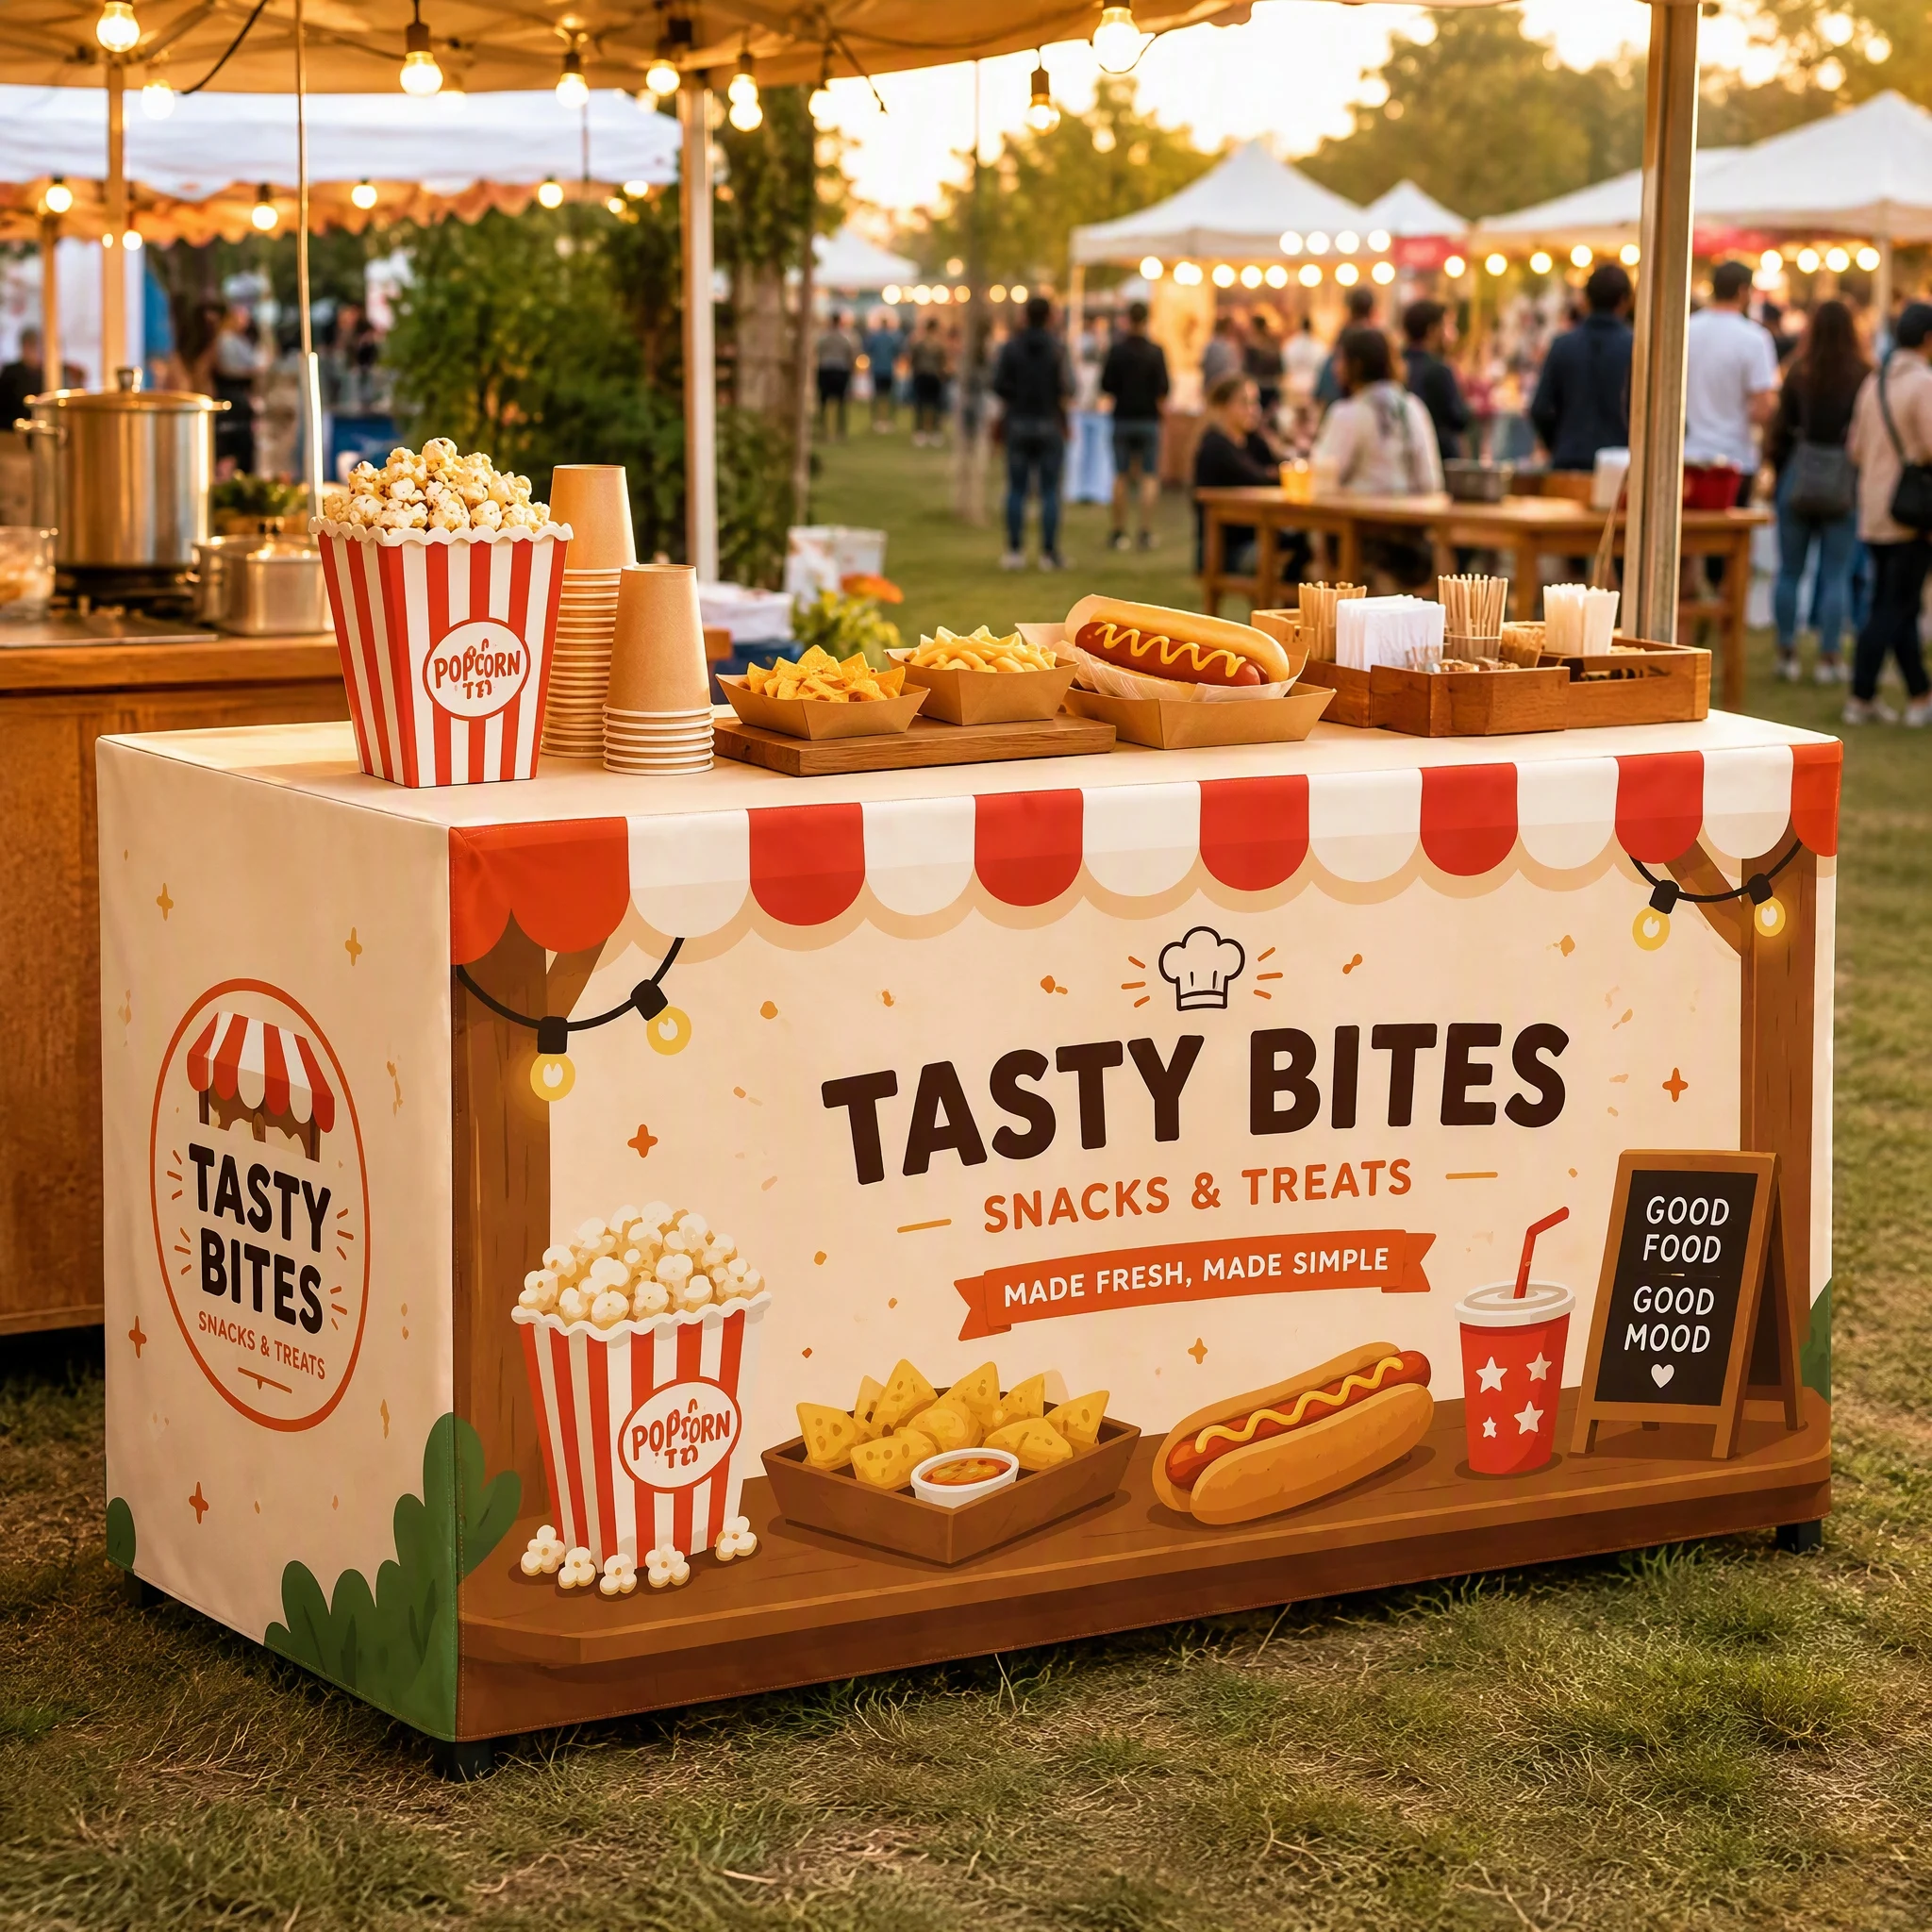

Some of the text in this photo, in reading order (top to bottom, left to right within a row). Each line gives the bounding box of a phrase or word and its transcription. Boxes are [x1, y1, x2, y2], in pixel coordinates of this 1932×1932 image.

[433, 649, 521, 690] POPCORN
[821, 1023, 1570, 1186] TASTY BITES
[188, 1142, 332, 1254] TASTY
[984, 1158, 1412, 1234] SNACKS & TREATS
[1646, 1195, 1730, 1226] GOOD
[1005, 1247, 1390, 1307] MADE FRESH, MADE SIMPLE
[1642, 1233, 1722, 1264] FOOD
[200, 1226, 324, 1335] BITES
[1633, 1285, 1715, 1316] GOOD
[198, 1310, 325, 1380] SNACKS & TREATS
[1624, 1323, 1711, 1354] MOOD
